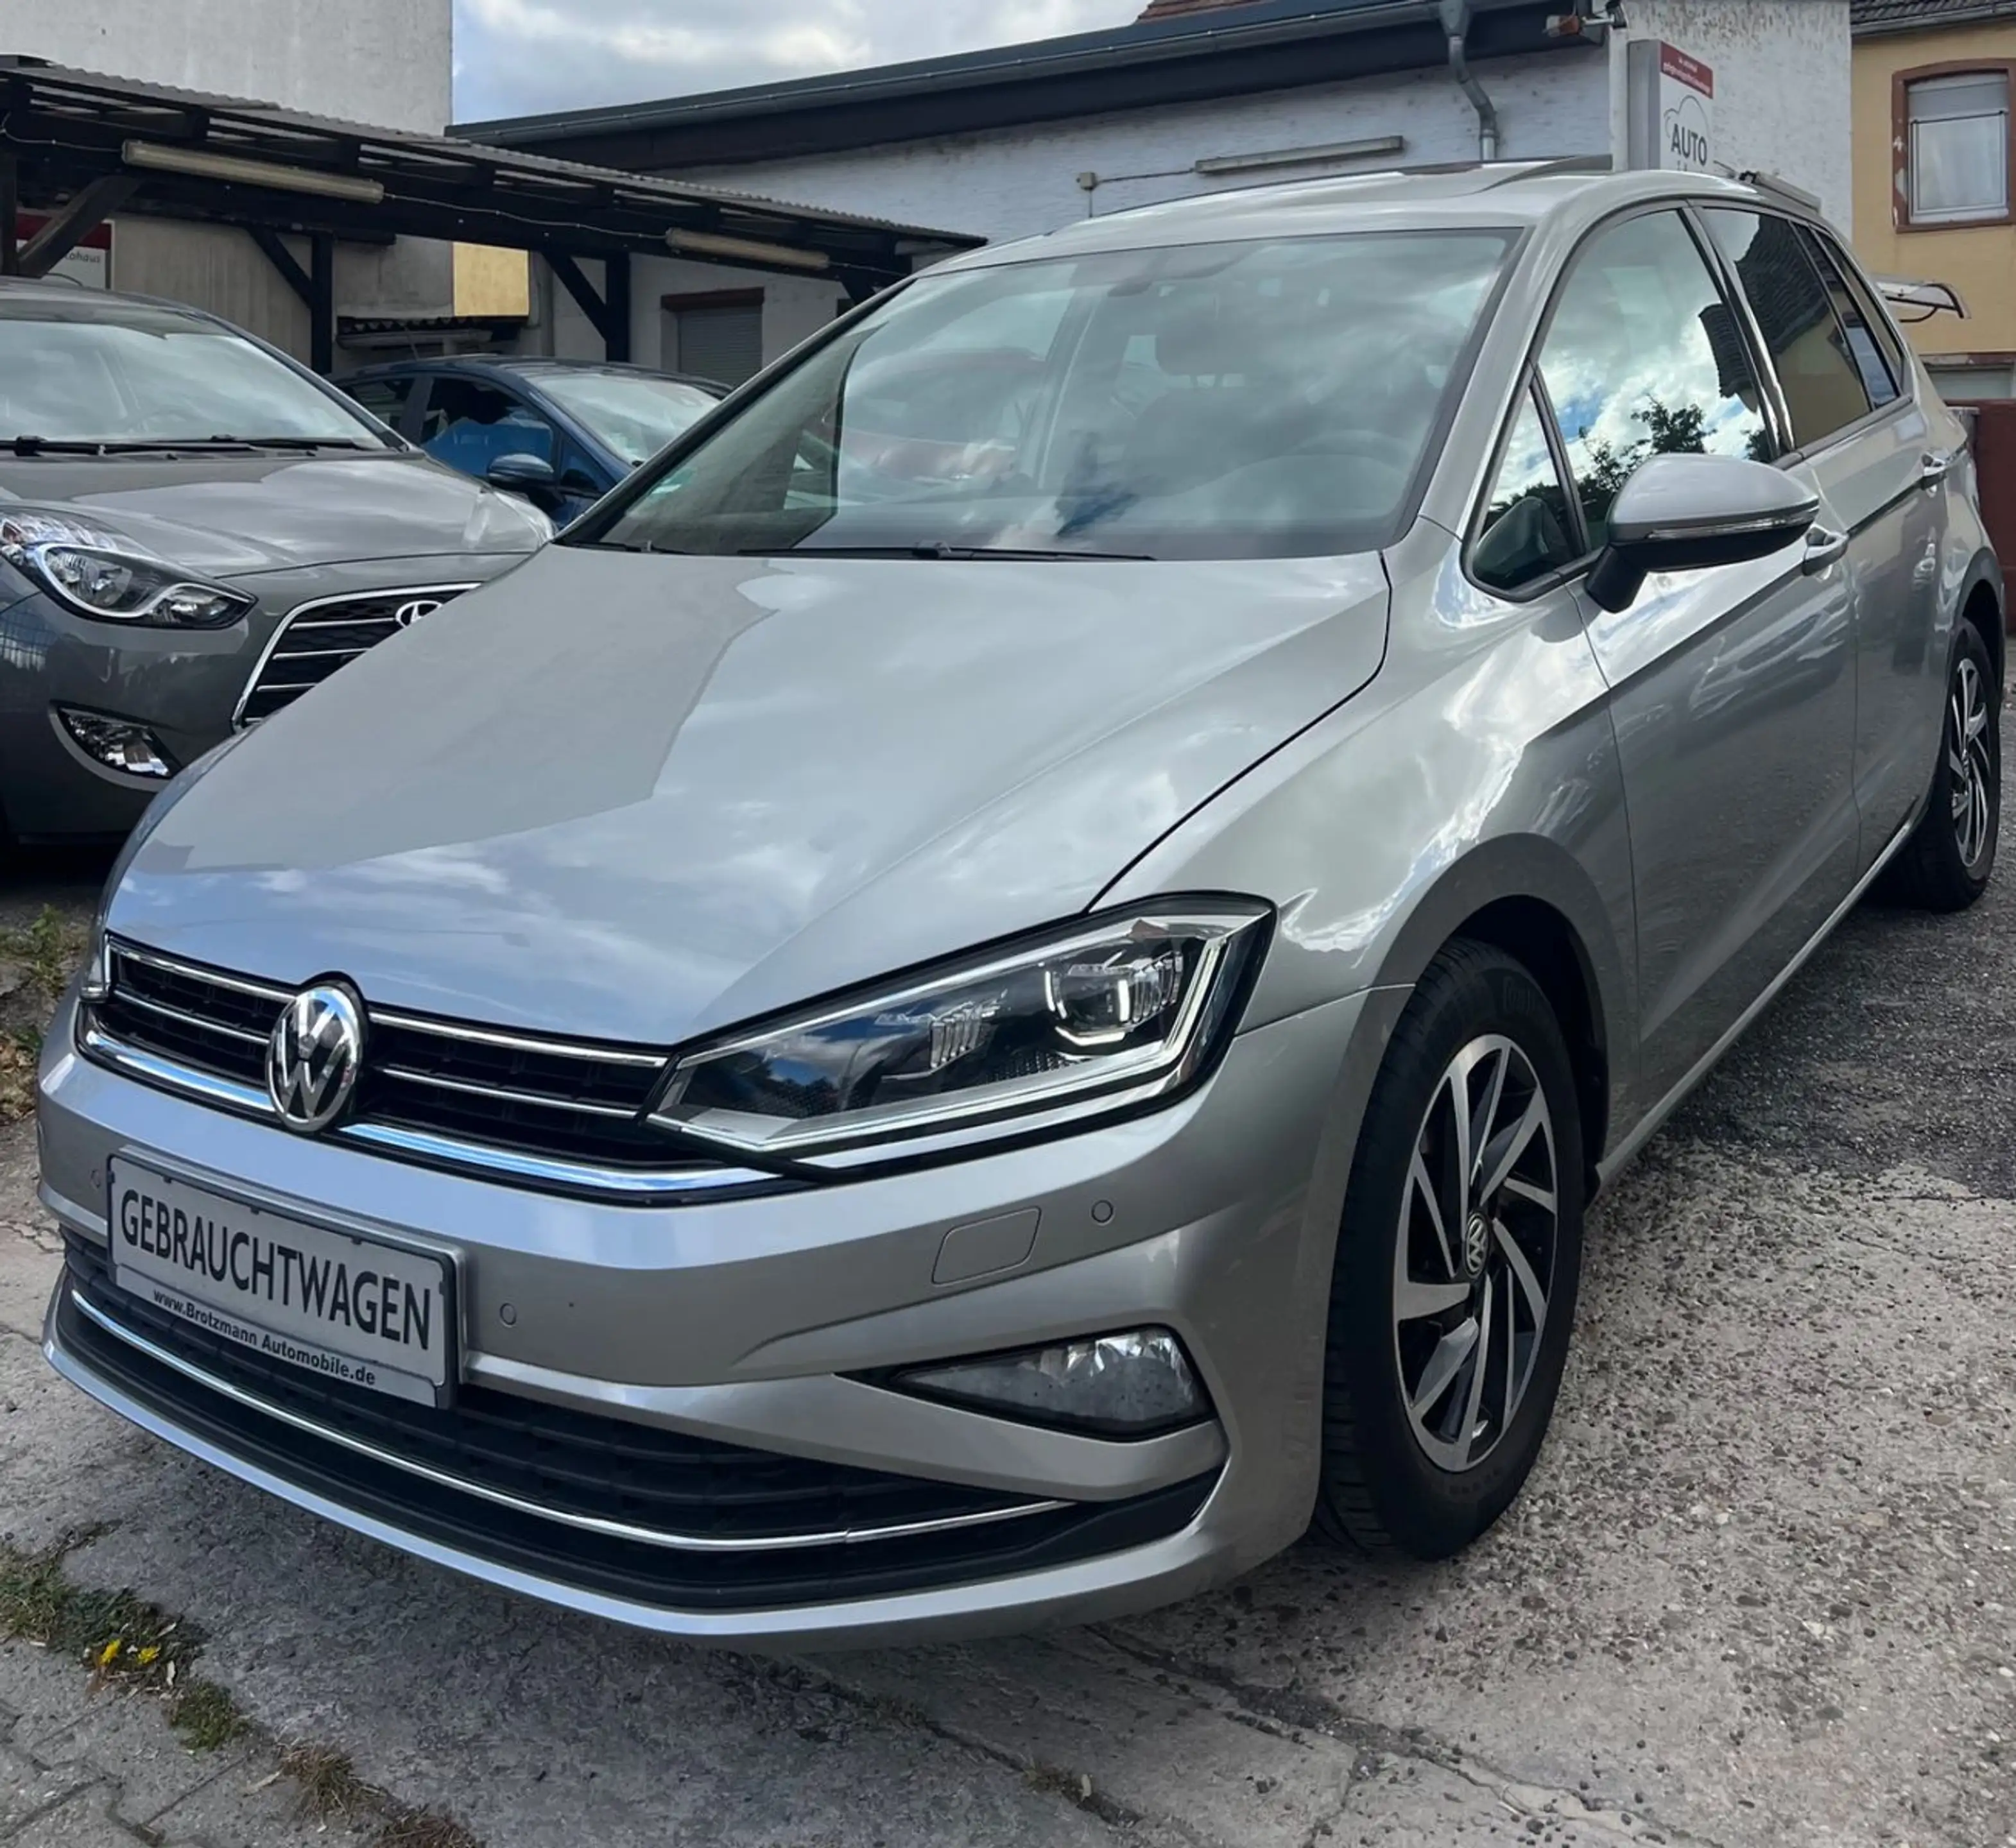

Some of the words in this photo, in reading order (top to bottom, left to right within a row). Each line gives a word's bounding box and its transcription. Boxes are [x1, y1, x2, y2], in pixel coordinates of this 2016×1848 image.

[1671, 123, 1707, 166] AUTO
[121, 1189, 431, 1351] GEBRAUCHTWAGEN
[153, 1289, 257, 1346] www.Brotzmann
[262, 1334, 375, 1385] Automobile.de
